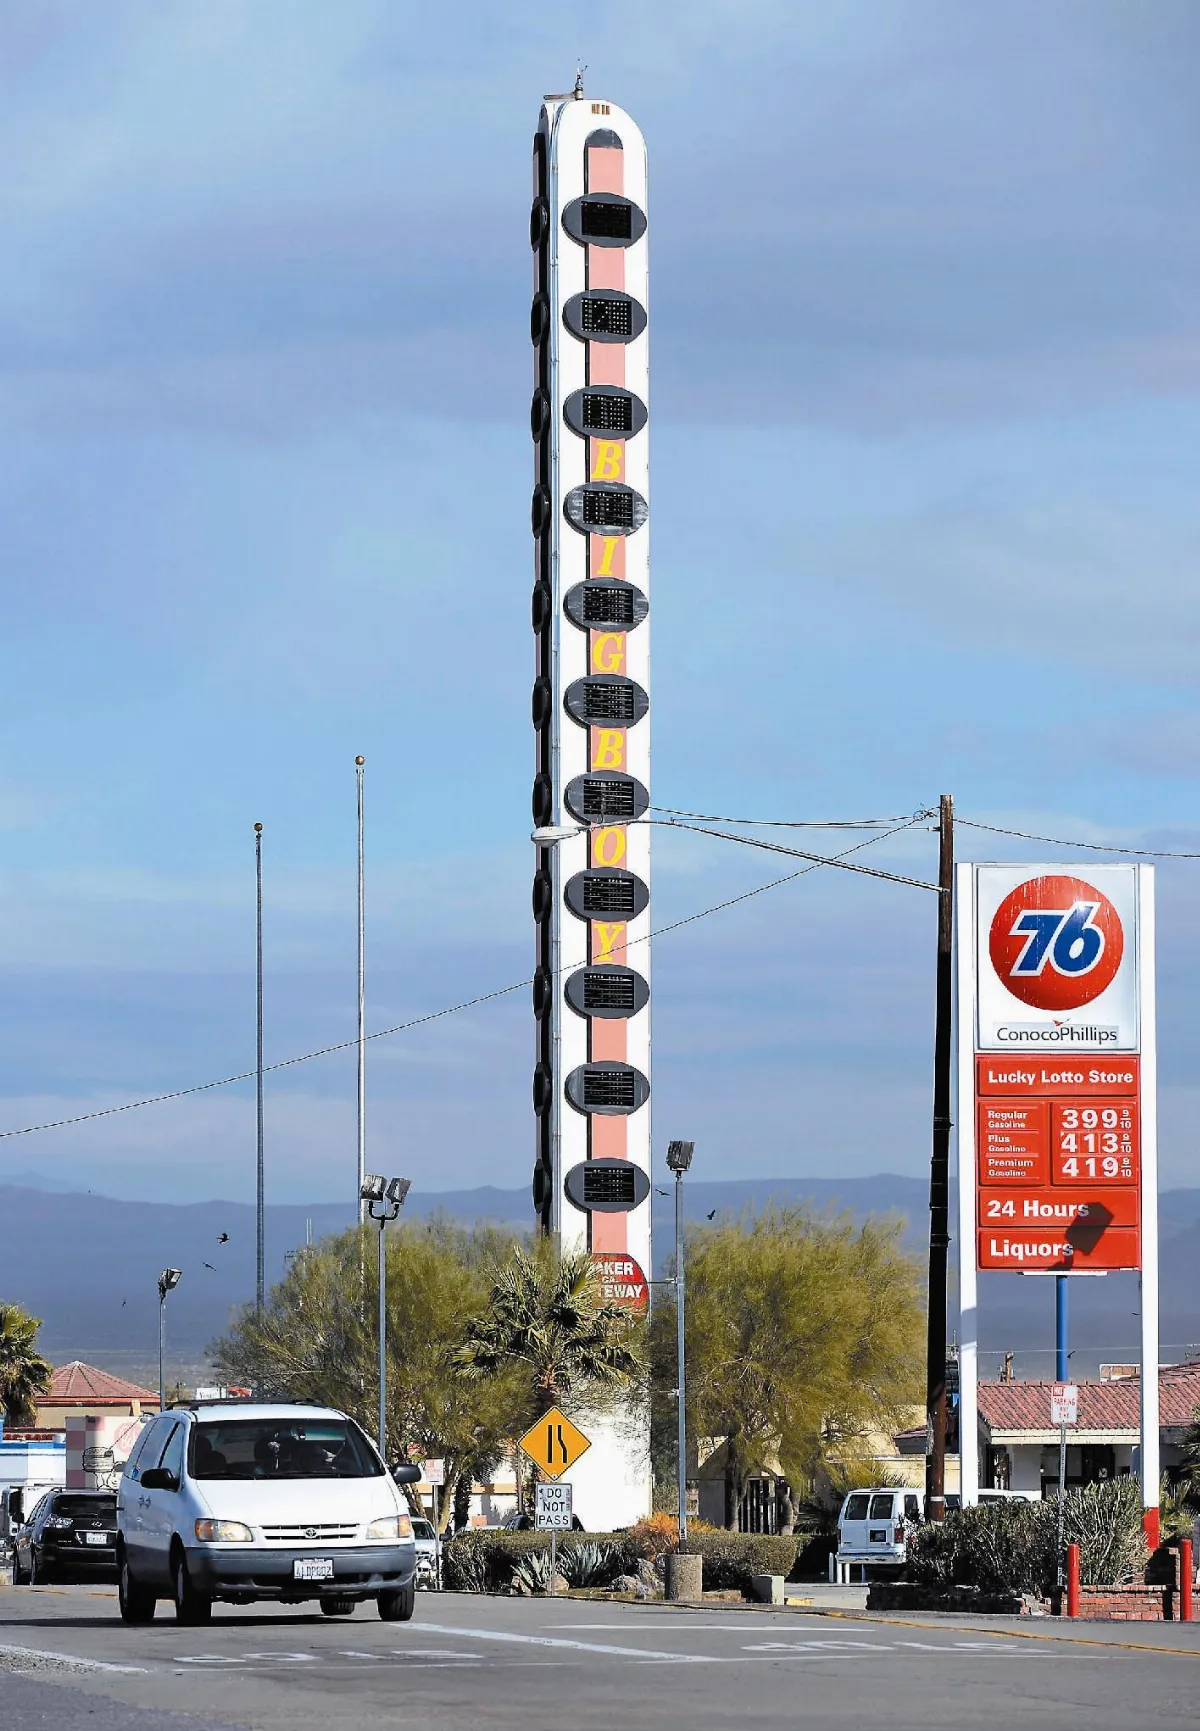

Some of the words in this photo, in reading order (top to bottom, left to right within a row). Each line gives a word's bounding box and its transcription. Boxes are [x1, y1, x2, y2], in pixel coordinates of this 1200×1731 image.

[1008, 900, 1105, 978] 76
[996, 1026, 1118, 1045] ConocoPhillips
[988, 1070, 1036, 1086] Lucky
[1041, 1070, 1084, 1084] Lotto
[1088, 1069, 1134, 1083] Store
[987, 1110, 1029, 1121] Regular
[1061, 1109, 1118, 1129] 399
[987, 1121, 1026, 1129] Gasoline
[987, 1134, 1011, 1143] Plus
[1060, 1133, 1119, 1153] 413
[987, 1145, 1027, 1153] Gasoline
[987, 1158, 1034, 1168] Premium
[1061, 1157, 1119, 1177] 419
[987, 1169, 1027, 1178] Gasoline
[986, 1200, 1016, 1217] 24
[1023, 1200, 1090, 1217] Hours
[990, 1239, 1074, 1260] Liquors
[589, 1261, 634, 1275] AKER
[547, 1488, 561, 1498] DO
[543, 1502, 565, 1511] NOT
[538, 1515, 569, 1525] PASS
